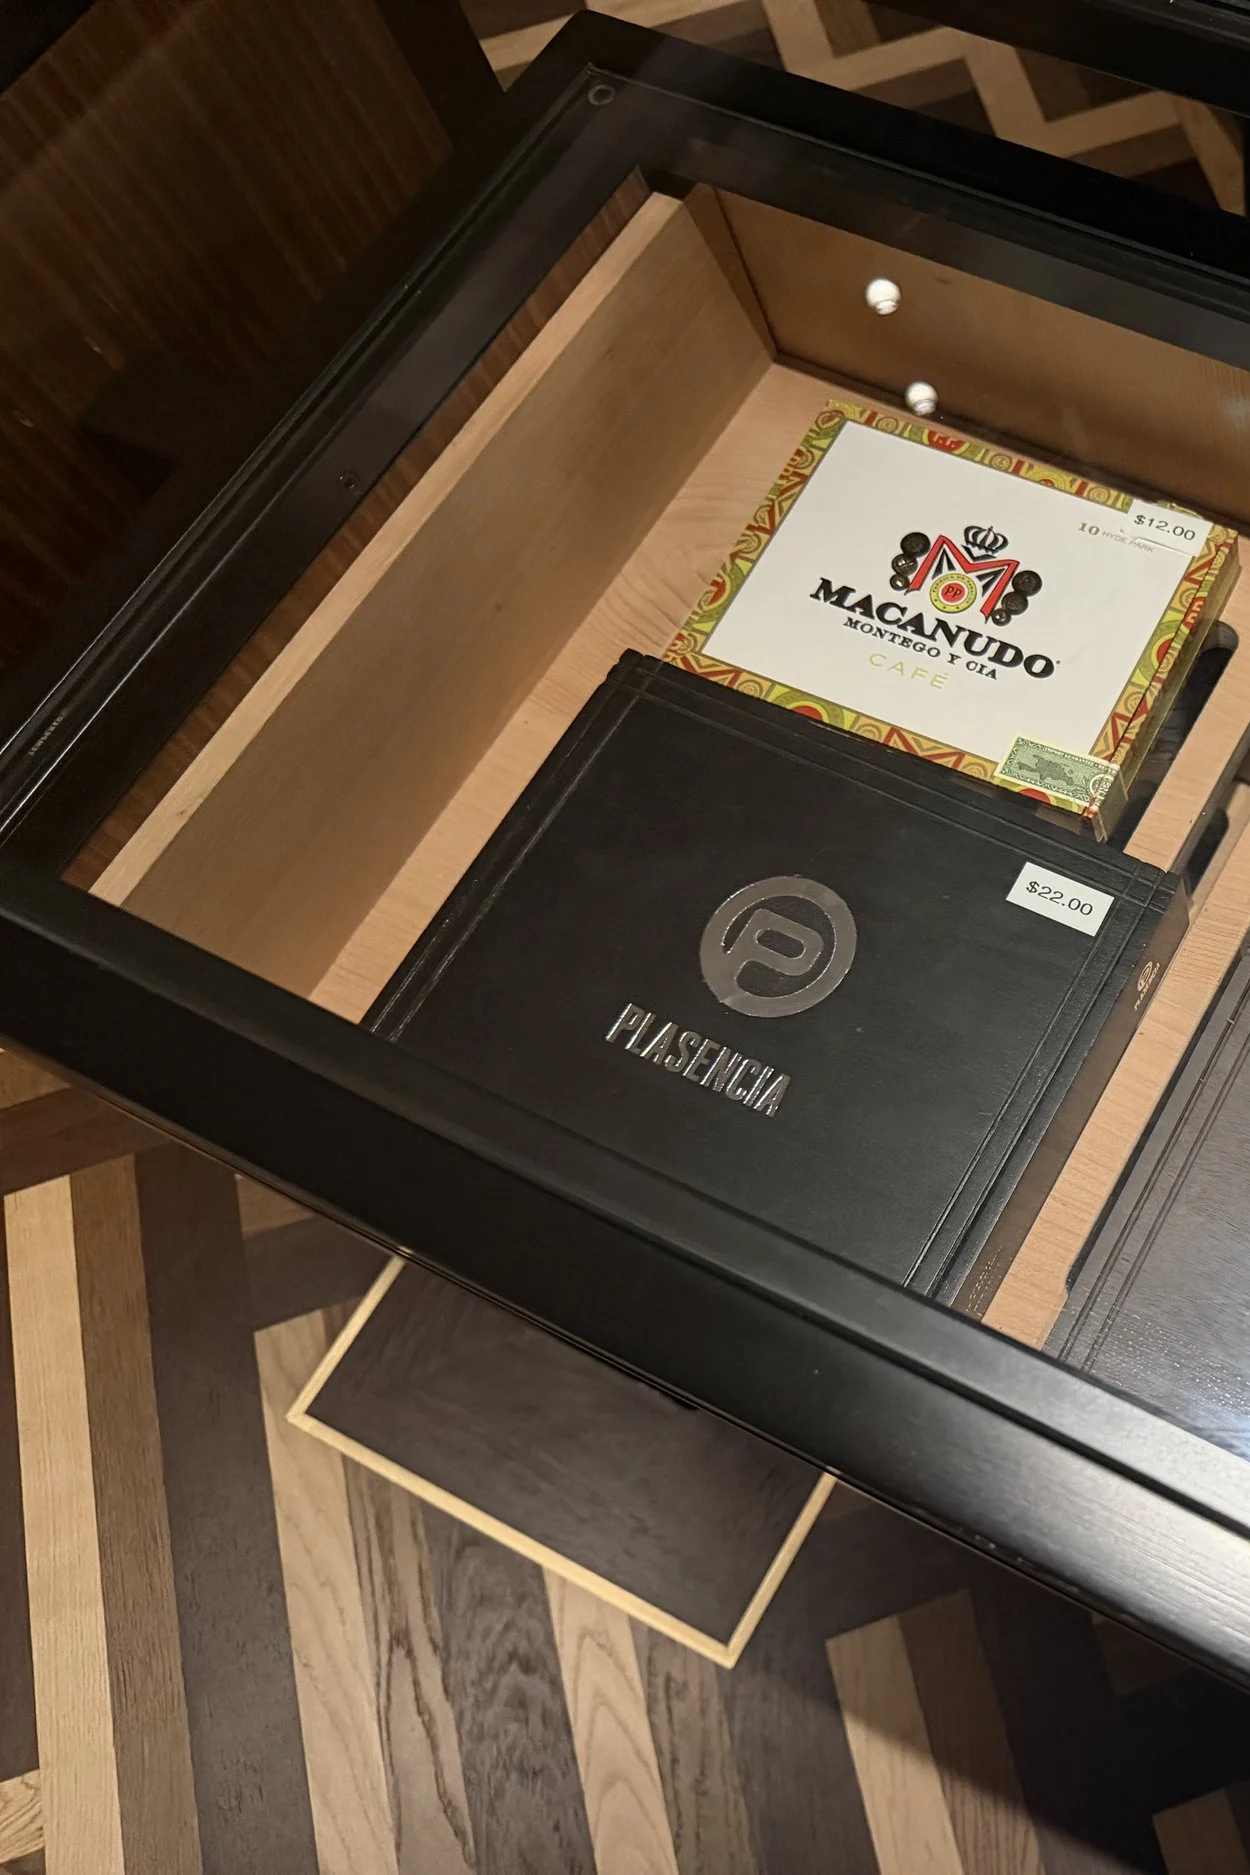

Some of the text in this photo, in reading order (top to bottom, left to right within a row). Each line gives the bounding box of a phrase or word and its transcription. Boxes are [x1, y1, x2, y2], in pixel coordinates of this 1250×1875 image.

[1078, 522, 1100, 536] 10
[1134, 514, 1196, 541] $12.00
[809, 577, 1056, 679] MACANUDO
[843, 617, 998, 680] MONTEGO Y CIA
[868, 653, 949, 689] CAFÉ
[1025, 881, 1093, 916] $22.00
[605, 1002, 792, 1118] PLASENCIA
